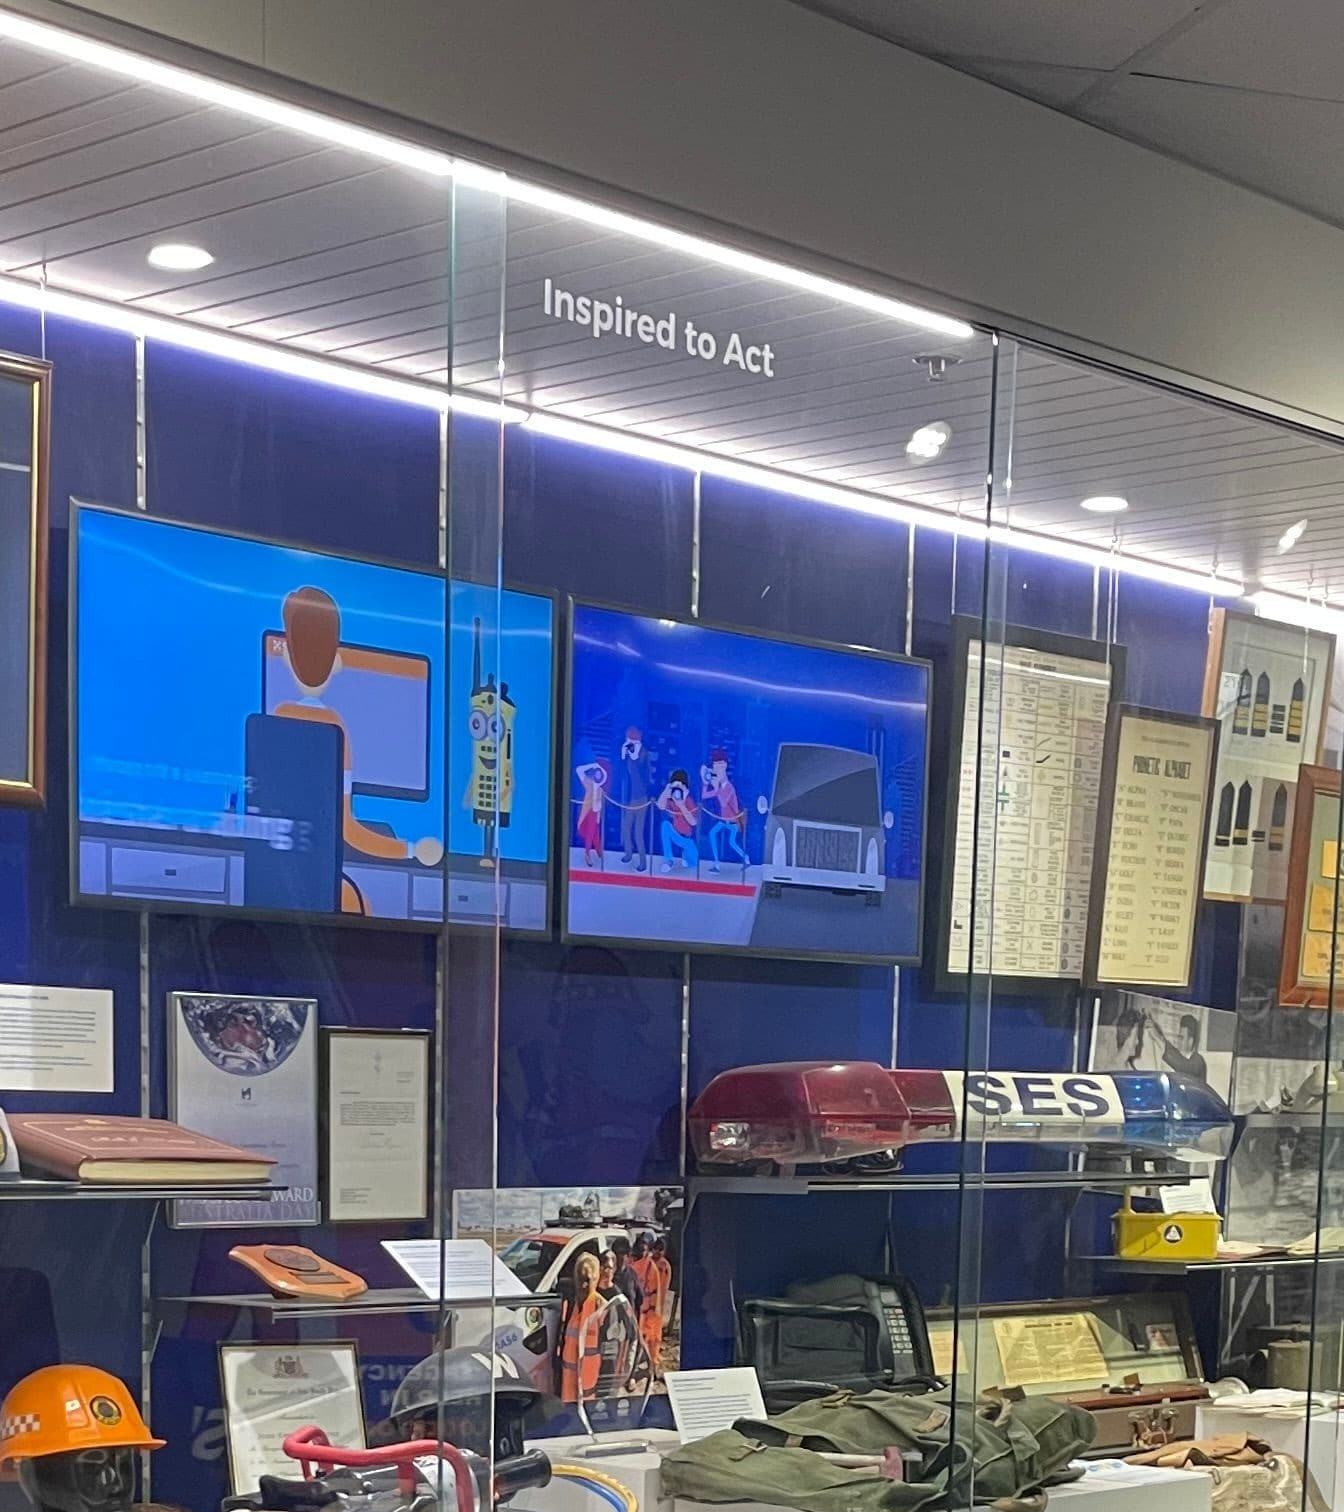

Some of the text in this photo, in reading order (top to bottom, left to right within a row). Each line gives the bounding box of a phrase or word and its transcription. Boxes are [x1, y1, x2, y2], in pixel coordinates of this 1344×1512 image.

[543, 279, 775, 378] Inspired to Act
[967, 1074, 1110, 1117] SES
[471, 1351, 520, 1380] W
